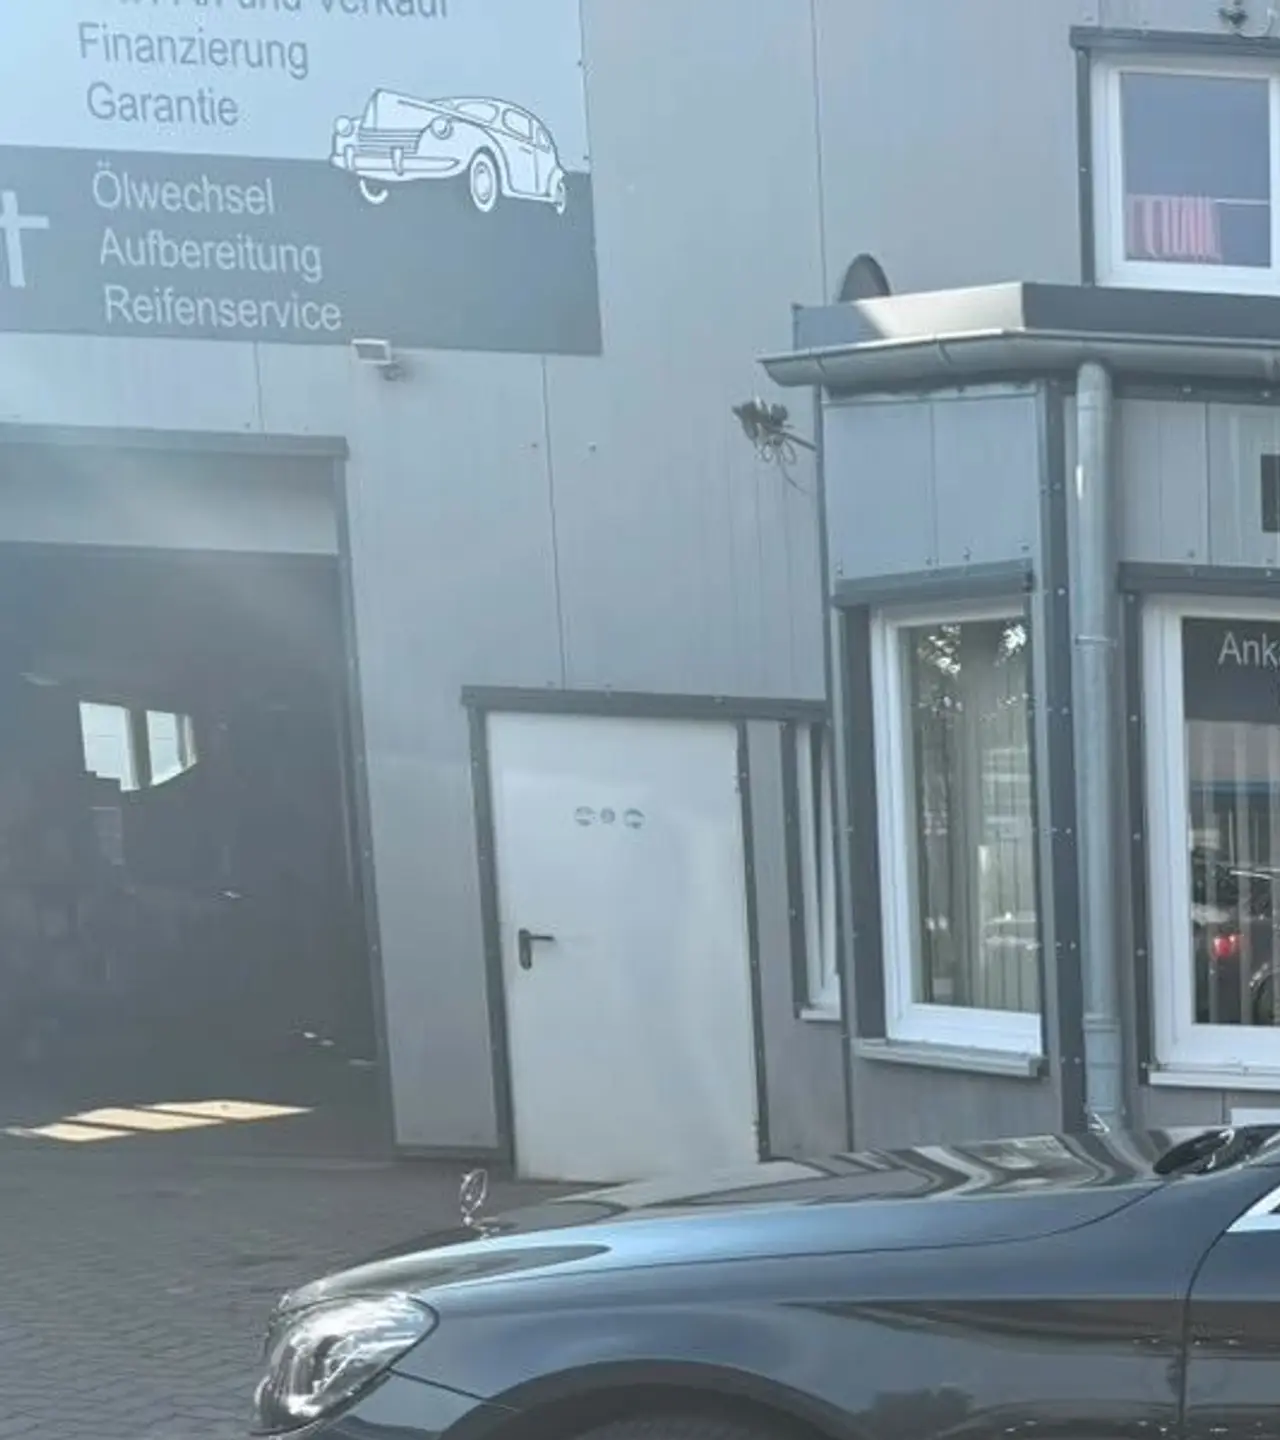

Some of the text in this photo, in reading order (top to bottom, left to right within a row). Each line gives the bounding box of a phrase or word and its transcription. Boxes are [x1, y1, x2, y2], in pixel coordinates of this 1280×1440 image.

[78, 21, 308, 79] Finanzierung
[87, 81, 238, 125] Garantie
[92, 161, 274, 216] Ölwechsel
[100, 228, 323, 282] Aufbereitung
[104, 285, 342, 331] Reifenservice
